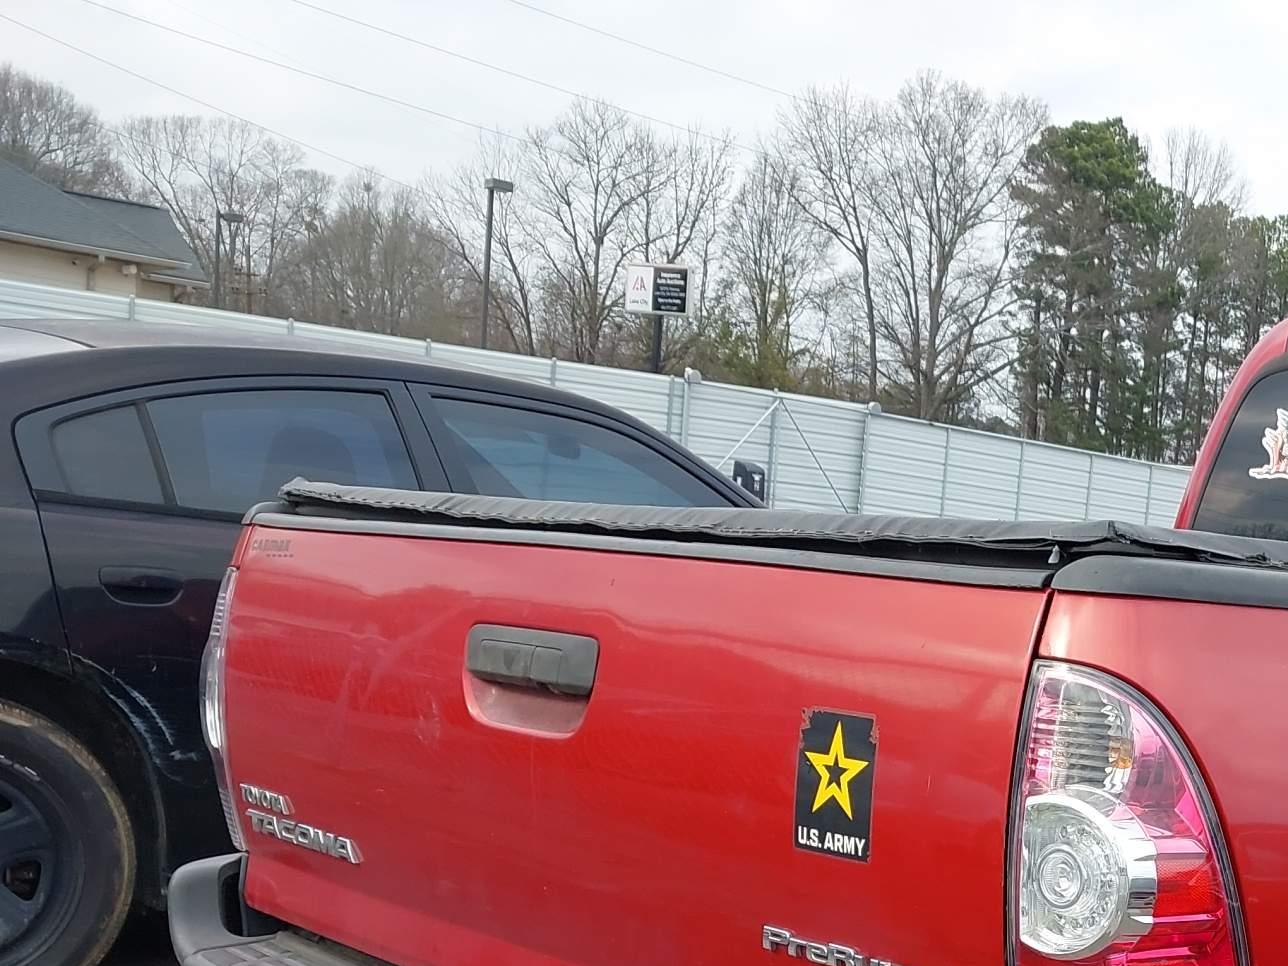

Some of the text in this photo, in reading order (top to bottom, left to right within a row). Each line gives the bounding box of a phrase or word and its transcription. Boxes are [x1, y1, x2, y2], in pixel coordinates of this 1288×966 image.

[246, 808, 361, 864] TACOMA
[797, 825, 866, 857] U.S. ARMY
